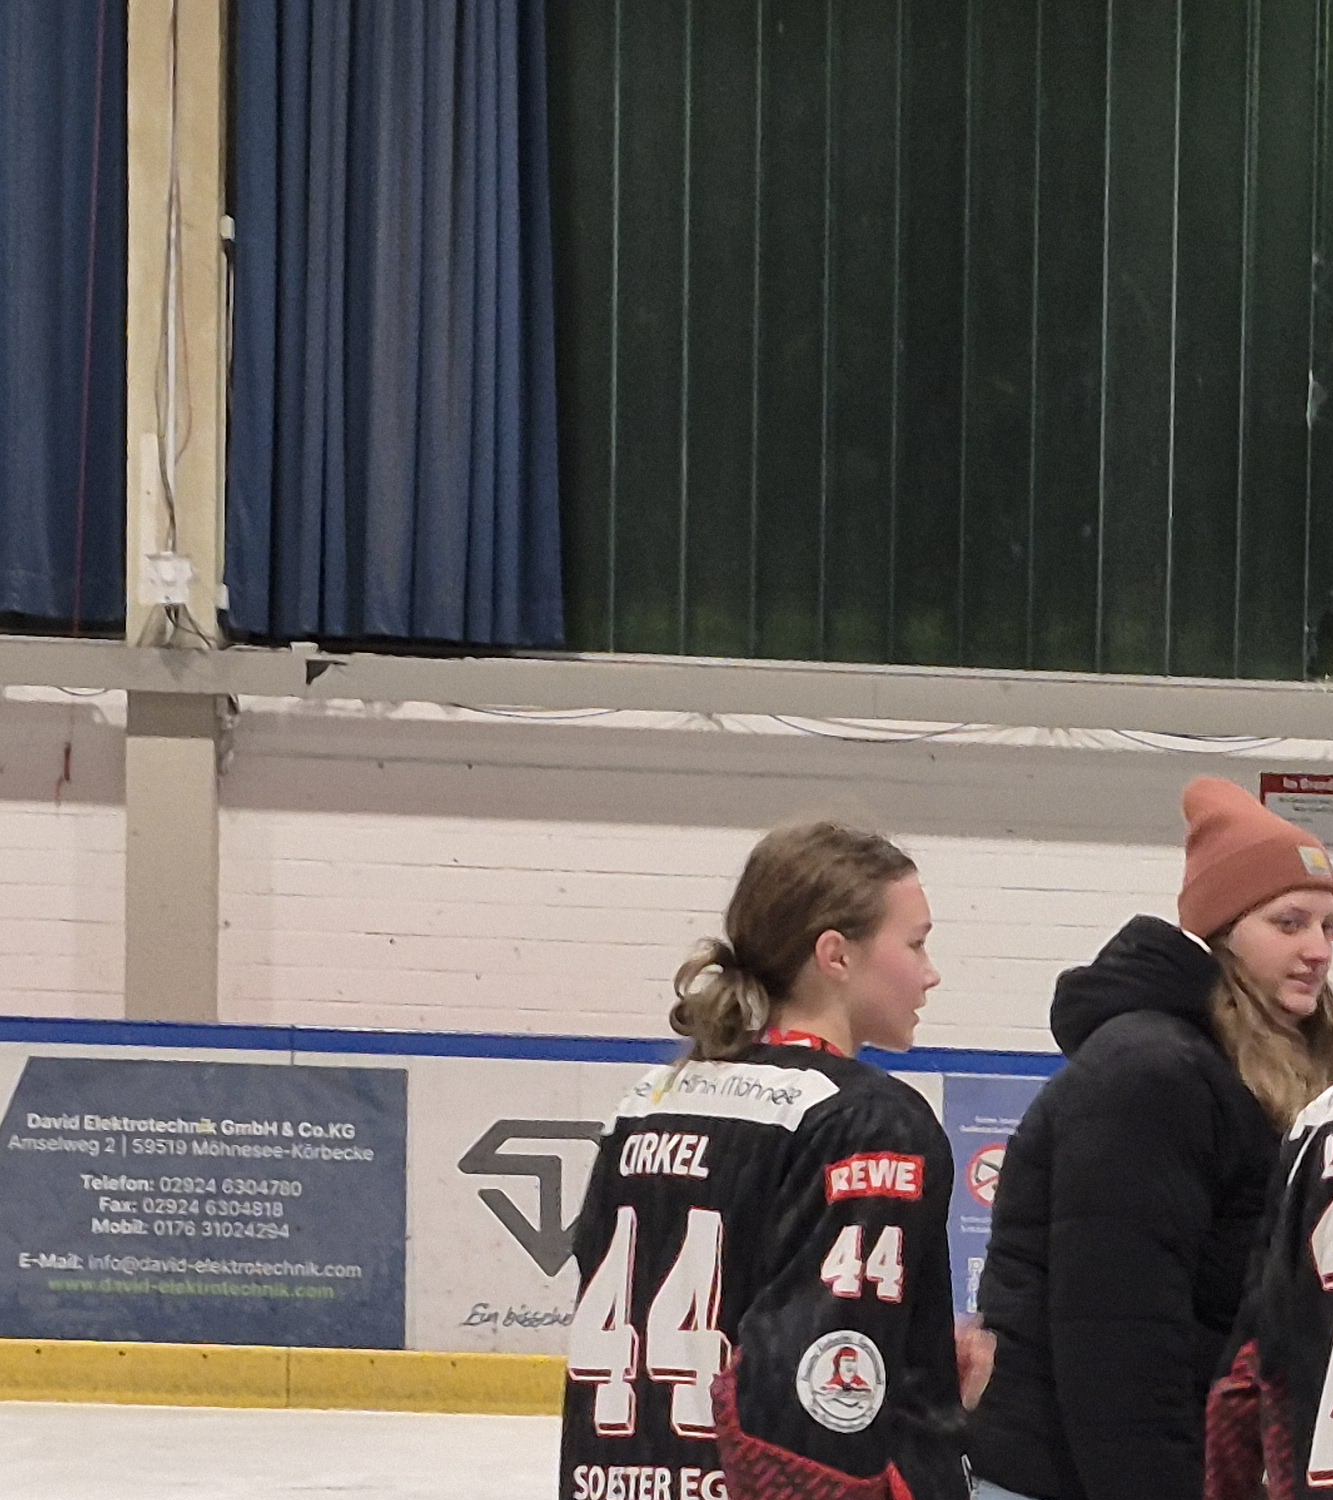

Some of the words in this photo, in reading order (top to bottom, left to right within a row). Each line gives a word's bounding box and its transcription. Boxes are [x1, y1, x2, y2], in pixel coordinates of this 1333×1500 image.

[26, 1113, 80, 1131] David
[84, 1114, 216, 1135] Elektrotechnik
[220, 1119, 278, 1136] GmbH
[281, 1121, 294, 1138] &
[298, 1122, 356, 1140] Co.KG
[8, 1134, 100, 1157] Amselweg
[104, 1137, 116, 1153] 2
[131, 1138, 188, 1155] 59519
[192, 1139, 375, 1162] Möhnesee-Körbecke
[80, 1174, 154, 1192] Telefon:
[159, 1177, 217, 1193] 02924
[830, 1160, 917, 1198] REWE
[98, 1196, 138, 1213] Fax:
[142, 1198, 200, 1215] 02924
[91, 1218, 149, 1235] Mobil:
[153, 1220, 196, 1236] 0176
[821, 1225, 904, 1303] 44
[568, 1205, 733, 1438] 44
